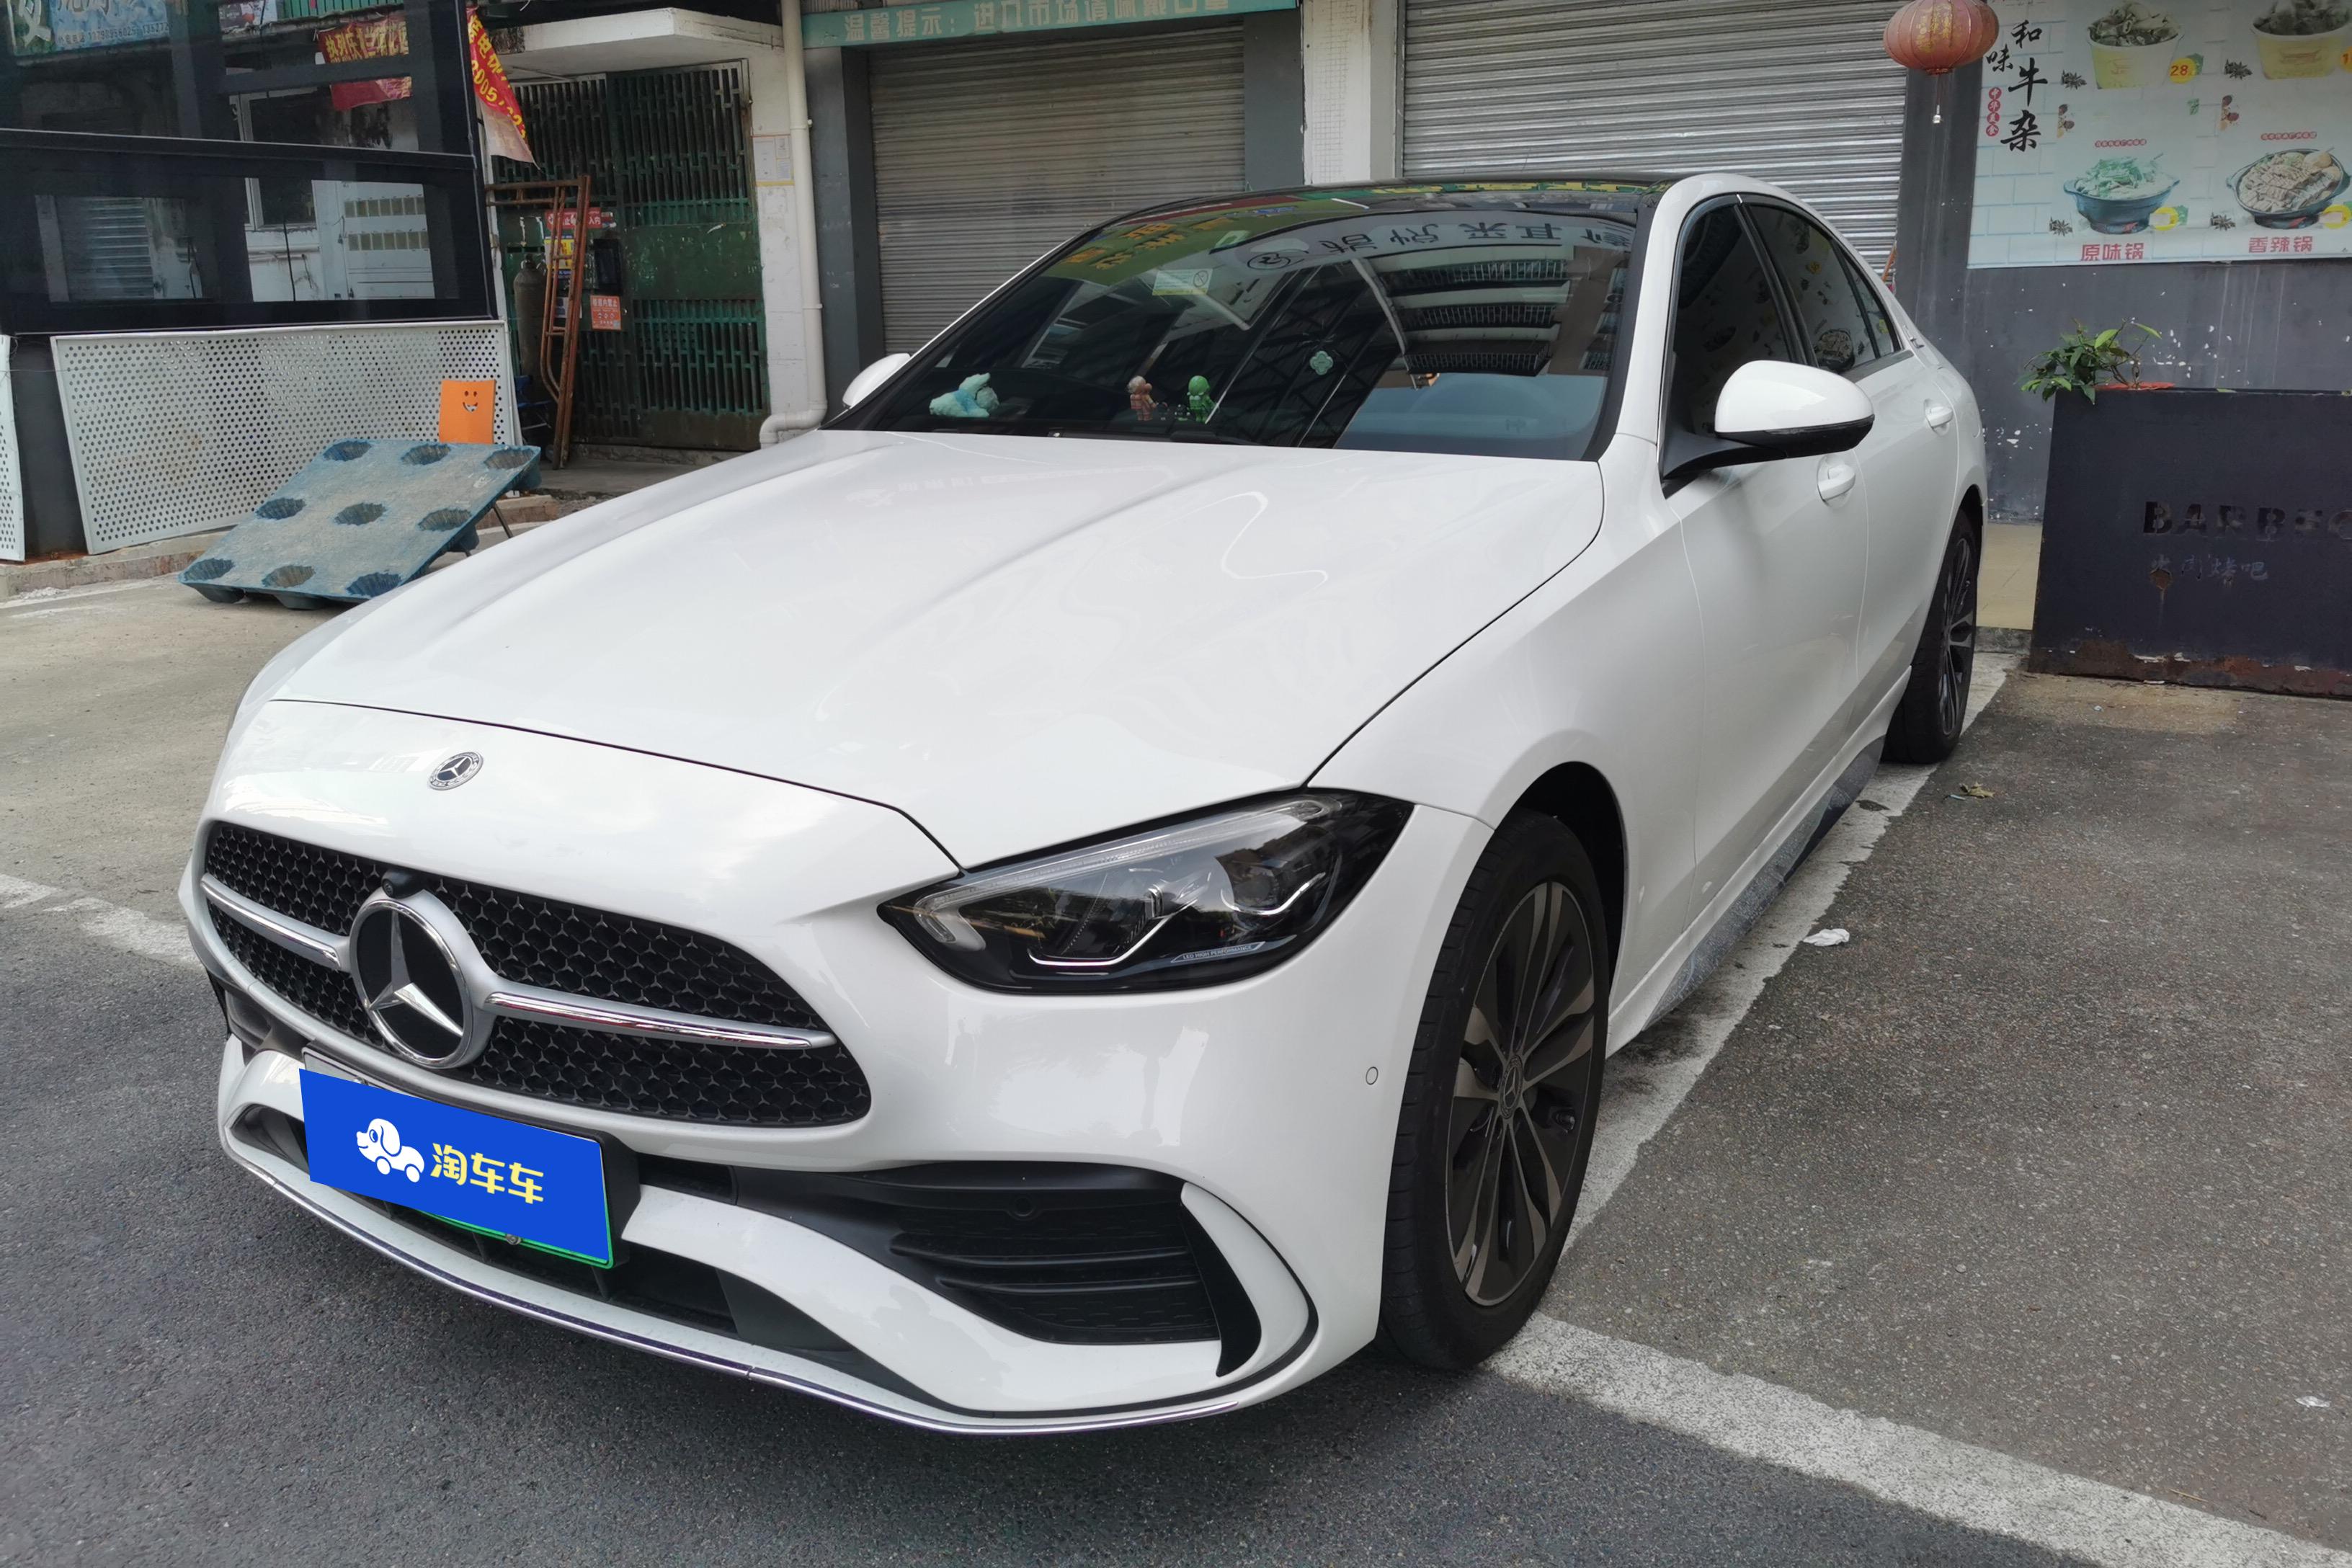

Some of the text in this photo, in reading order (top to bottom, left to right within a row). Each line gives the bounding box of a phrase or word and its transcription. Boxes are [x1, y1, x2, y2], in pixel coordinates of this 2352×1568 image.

[2170, 65, 2188, 76] 28
[2081, 243, 2144, 261] 原味锅
[2248, 236, 2314, 254] 香辣锅
[1211, 945, 1252, 956] PERFORMANCE
